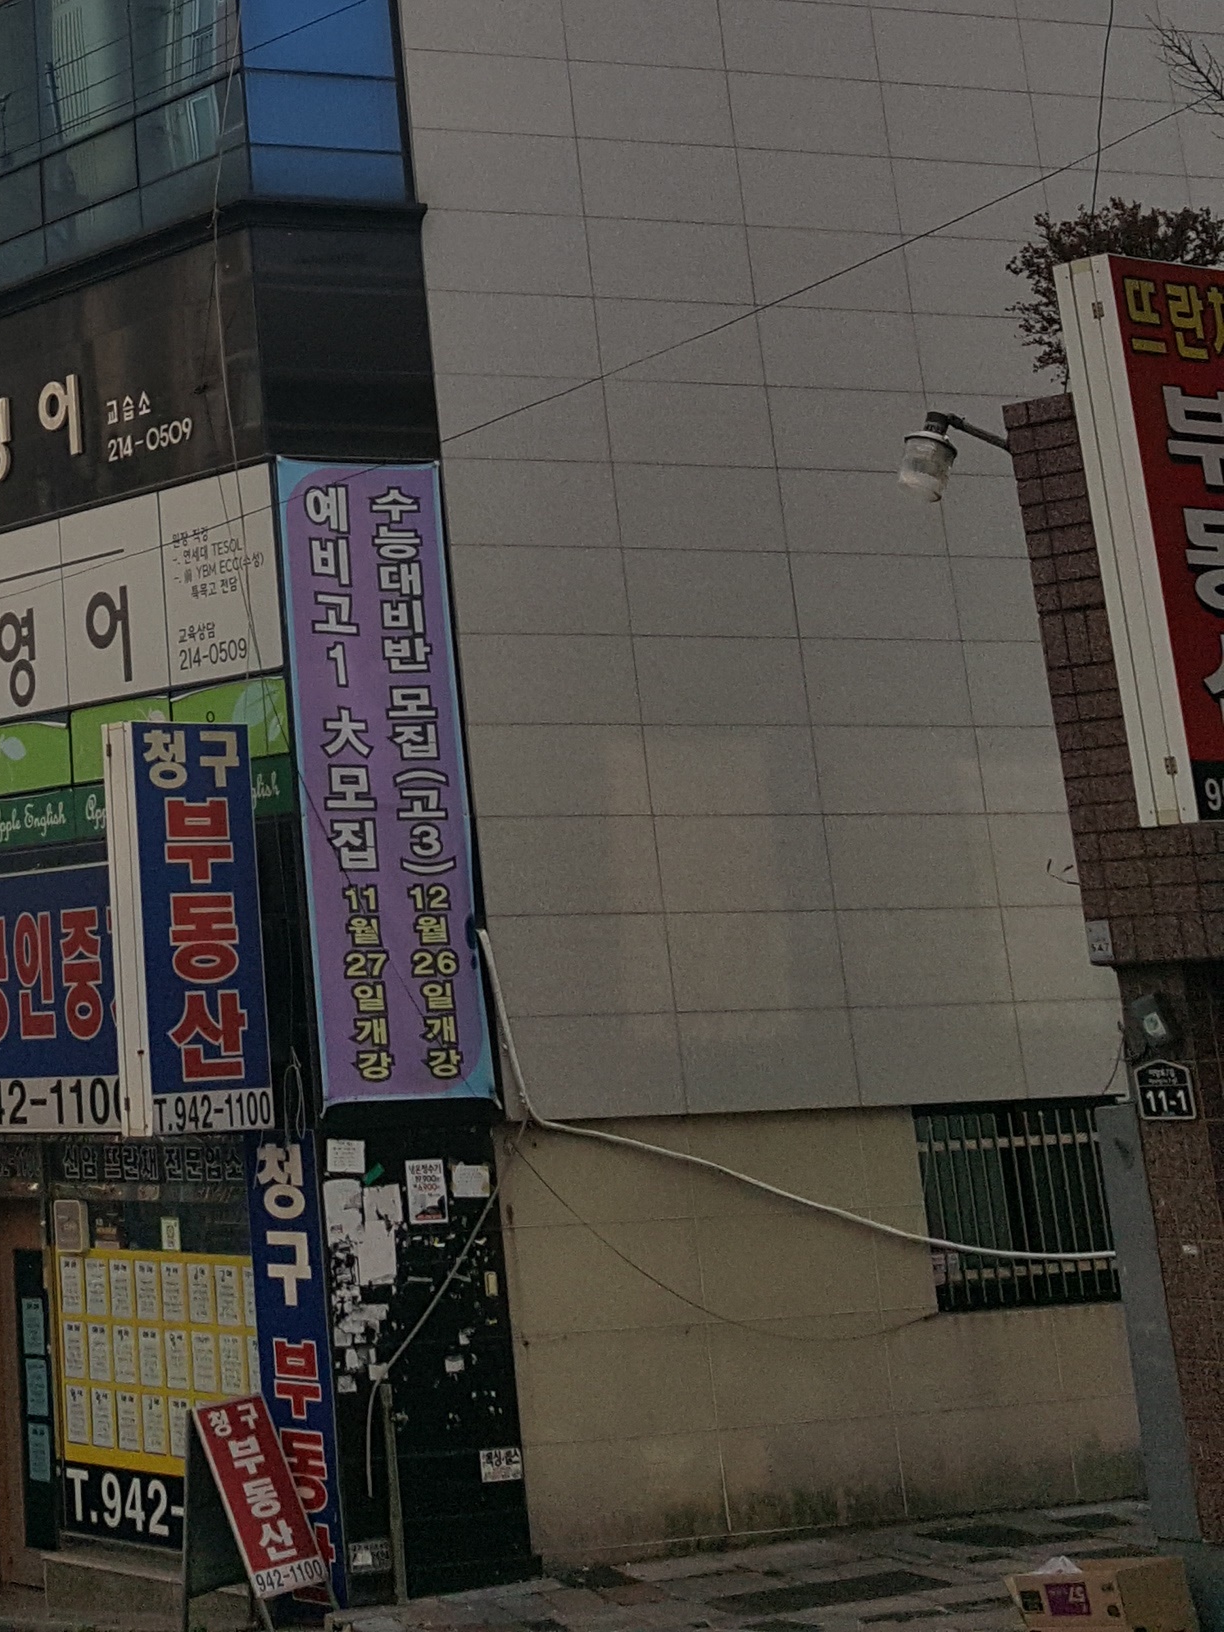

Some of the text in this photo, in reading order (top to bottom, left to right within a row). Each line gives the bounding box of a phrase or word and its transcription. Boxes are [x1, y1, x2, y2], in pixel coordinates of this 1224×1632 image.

[105, 390, 152, 426] 교습소
[107, 417, 193, 463] 214-0509
[183, 538, 244, 565] 연세대 TESOL
[196, 561, 217, 580] YBM
[220, 575, 238, 594] 전담
[304, 483, 360, 688] 예비고1
[368, 485, 432, 674] 수능대비반
[178, 621, 216, 644] 교육상담
[179, 636, 248, 671] 214-0509
[142, 728, 241, 790] 청구
[24, 795, 68, 837] English
[163, 795, 248, 1084] 부동산
[153, 1087, 272, 1133] T.942-1100
[1146, 1089, 1190, 1114] 11-1
[163, 1145, 246, 1183] 전문업소
[256, 1143, 313, 1307] 청구
[207, 1402, 259, 1438] 청구
[228, 1434, 298, 1563] 부동산
[256, 1559, 324, 1593] 942-1100
